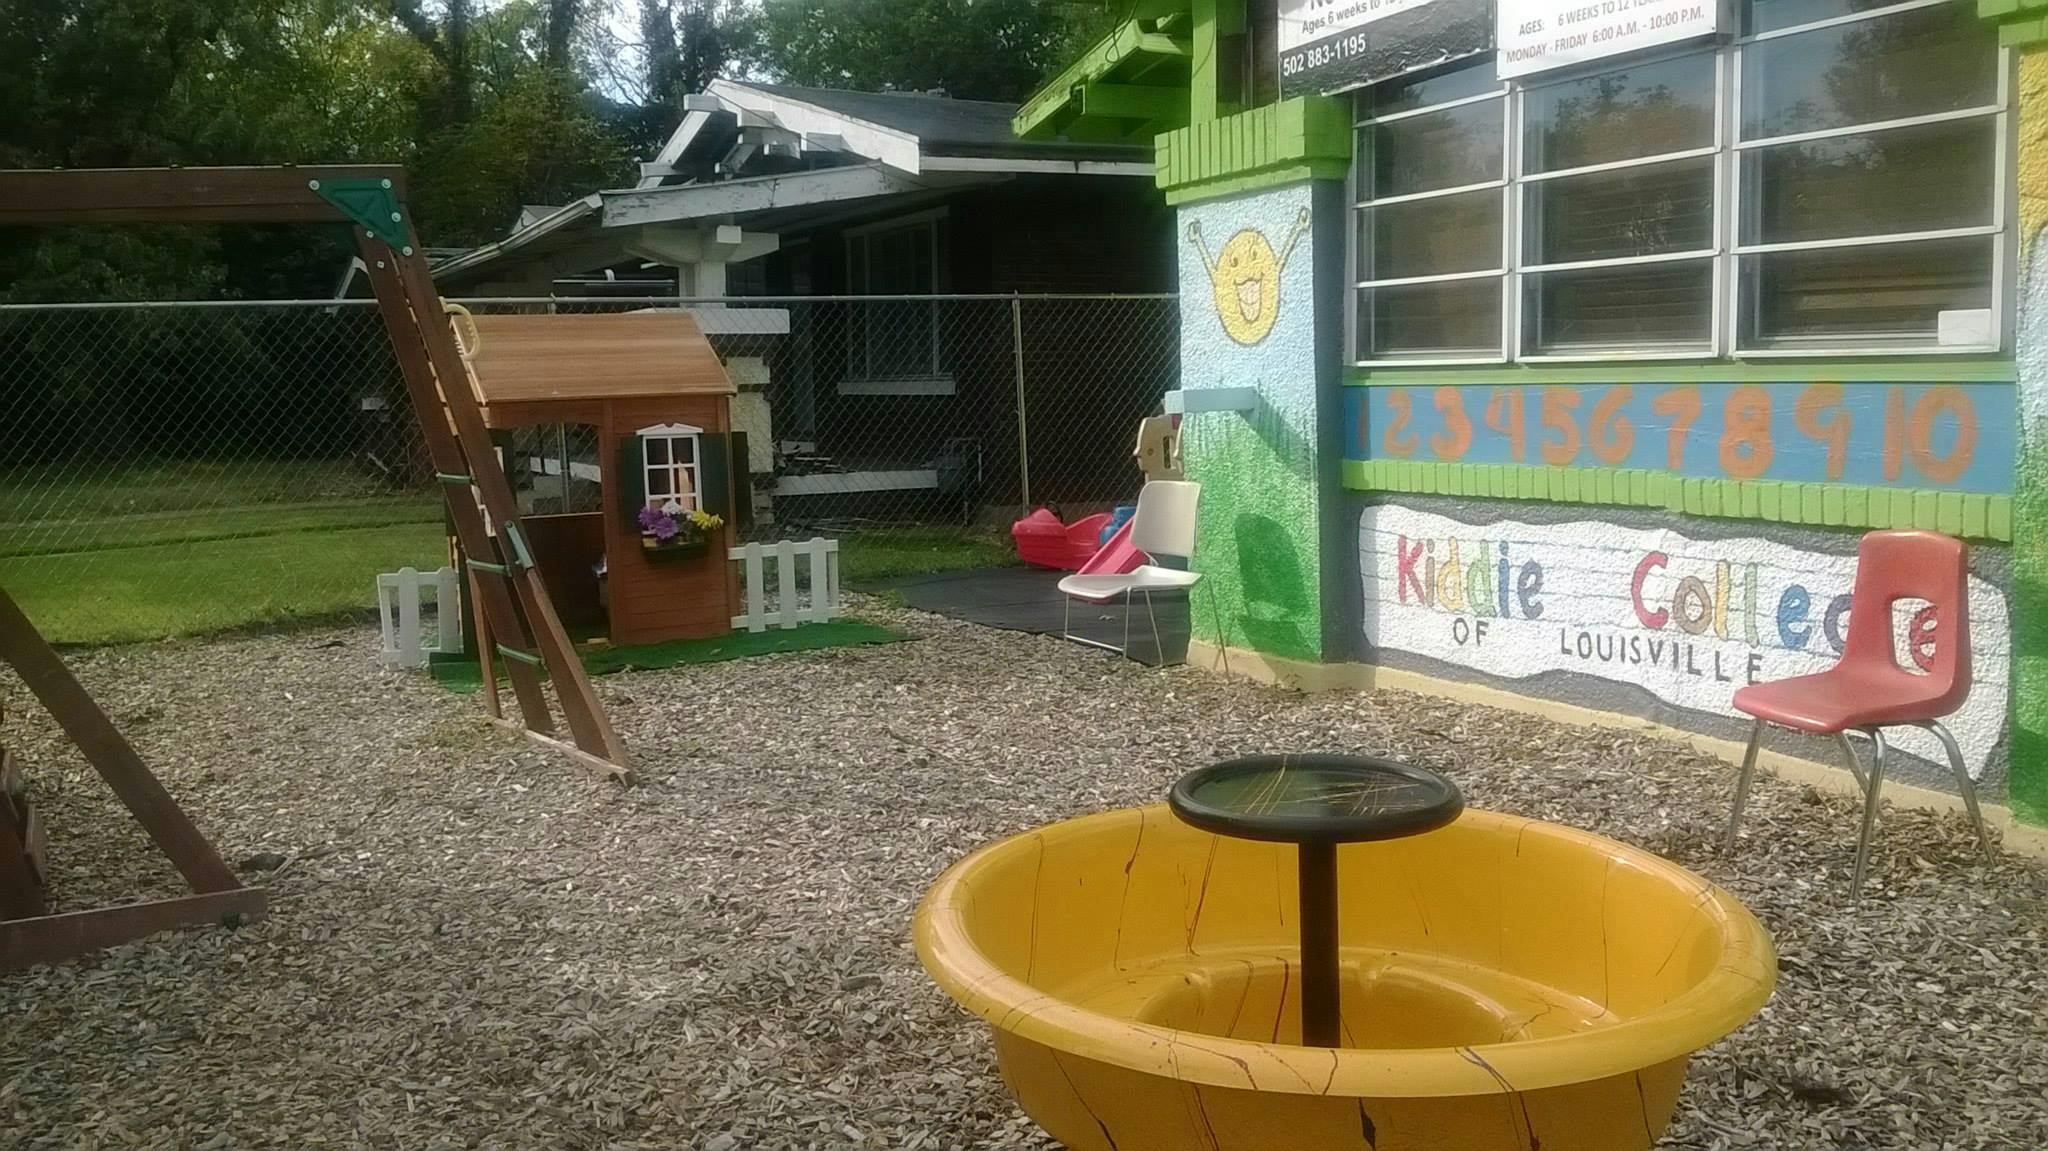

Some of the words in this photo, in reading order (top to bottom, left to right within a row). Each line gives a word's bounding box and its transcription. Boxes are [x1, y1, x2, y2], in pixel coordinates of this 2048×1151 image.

[1302, 17, 1325, 34] Ages
[1327, 11, 1334, 24] 6
[1336, 2, 1367, 20] weeks
[1506, 43, 1547, 63] MONDAY
[1554, 33, 1588, 51] FRIDAY
[1592, 27, 1614, 42] 6:00
[1615, 21, 1641, 38] A.M.
[1650, 11, 1679, 29] 10:00
[1680, 6, 1705, 23] P.M.
[1518, 19, 1545, 36] AGES:
[1557, 14, 1564, 26] 6
[1566, 4, 1599, 24] WEEKS
[1601, 1, 1615, 15] TO
[1283, 53, 1305, 77] 502
[1307, 33, 1366, 69] 883-1195
[1384, 390, 1418, 457] 2
[1430, 386, 1472, 463] 3
[1485, 387, 1524, 463] 4
[1540, 387, 1580, 466] 5
[1588, 385, 1635, 465] 6
[1652, 387, 1701, 470] 7
[1718, 385, 1774, 479] 8
[1793, 381, 1851, 481] 9
[1882, 387, 1978, 483] 10
[1398, 534, 1544, 620] Kiddie
[1453, 616, 1489, 647] OF
[1561, 628, 1763, 684] LOUISVILLE
